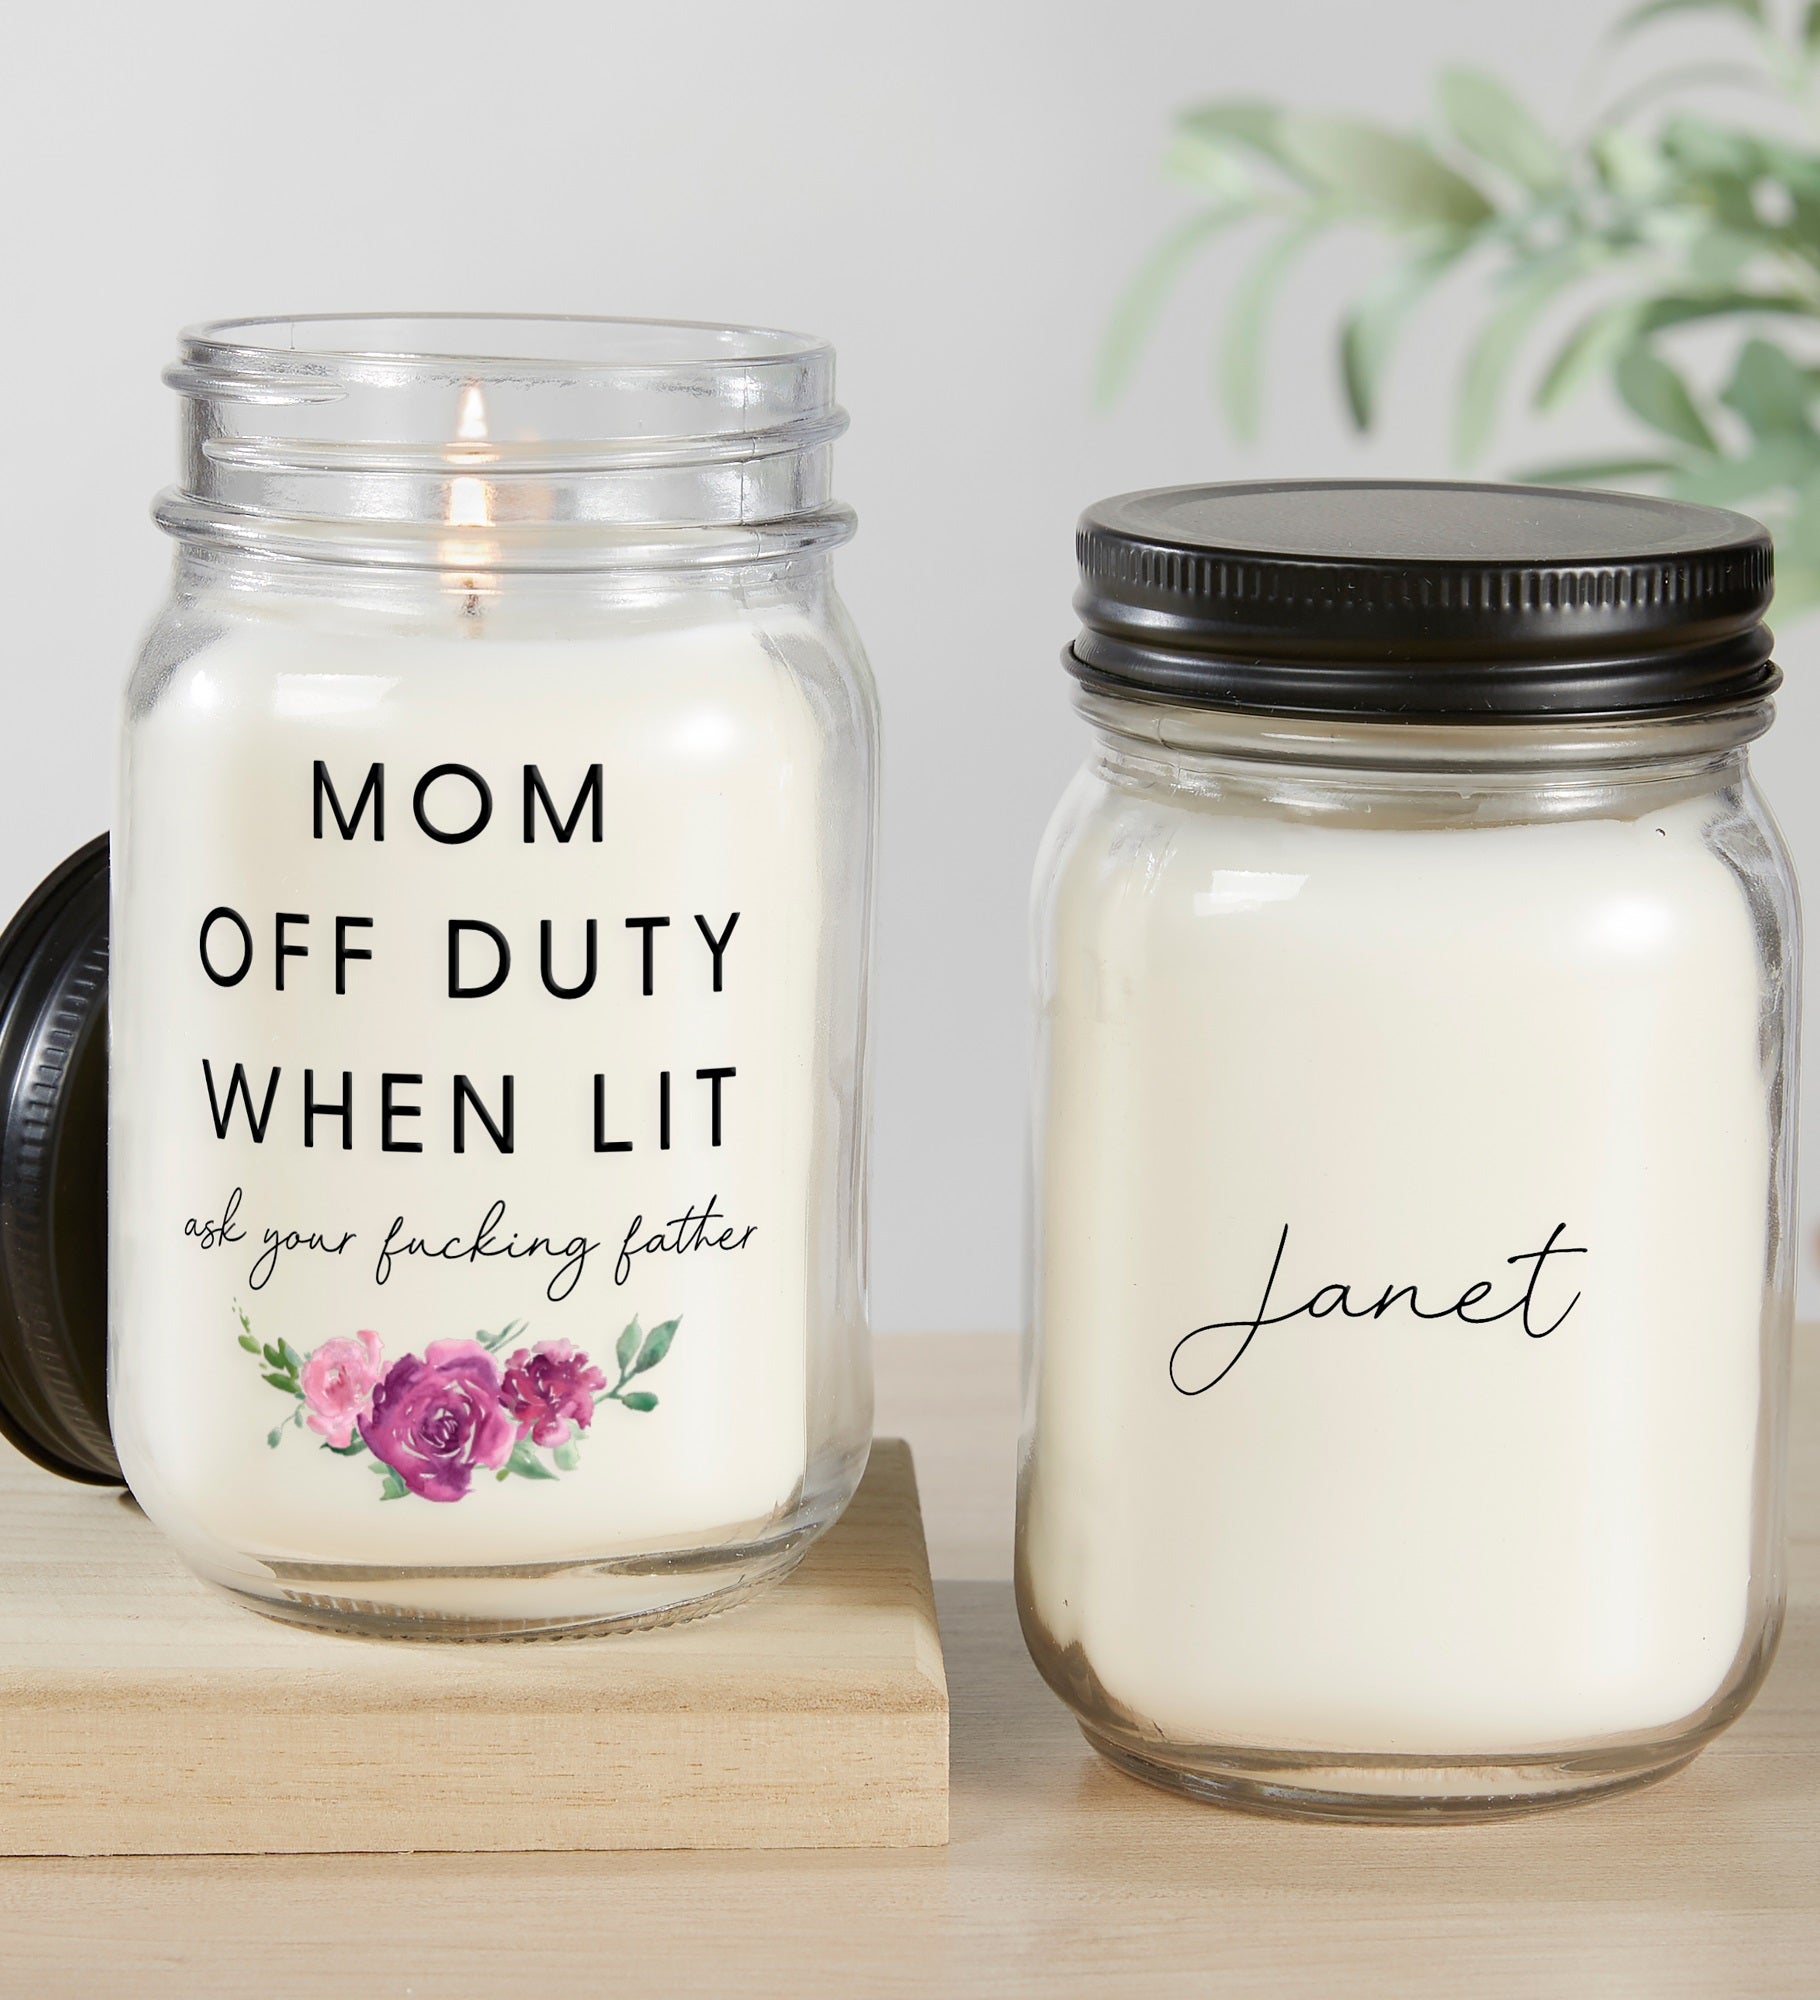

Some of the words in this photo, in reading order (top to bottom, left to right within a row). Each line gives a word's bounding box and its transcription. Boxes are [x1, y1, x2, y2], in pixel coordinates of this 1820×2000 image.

[314, 760, 602, 844] MOM
[200, 907, 373, 996] OFF
[449, 912, 740, 999] DUTY
[202, 1059, 514, 1153] WHEN
[594, 1067, 736, 1152] LIT
[185, 1187, 246, 1250] ask
[249, 1229, 357, 1291] your
[376, 1200, 600, 1302] fucking
[615, 1194, 758, 1286] father
[1169, 1222, 1588, 1396] Janet
